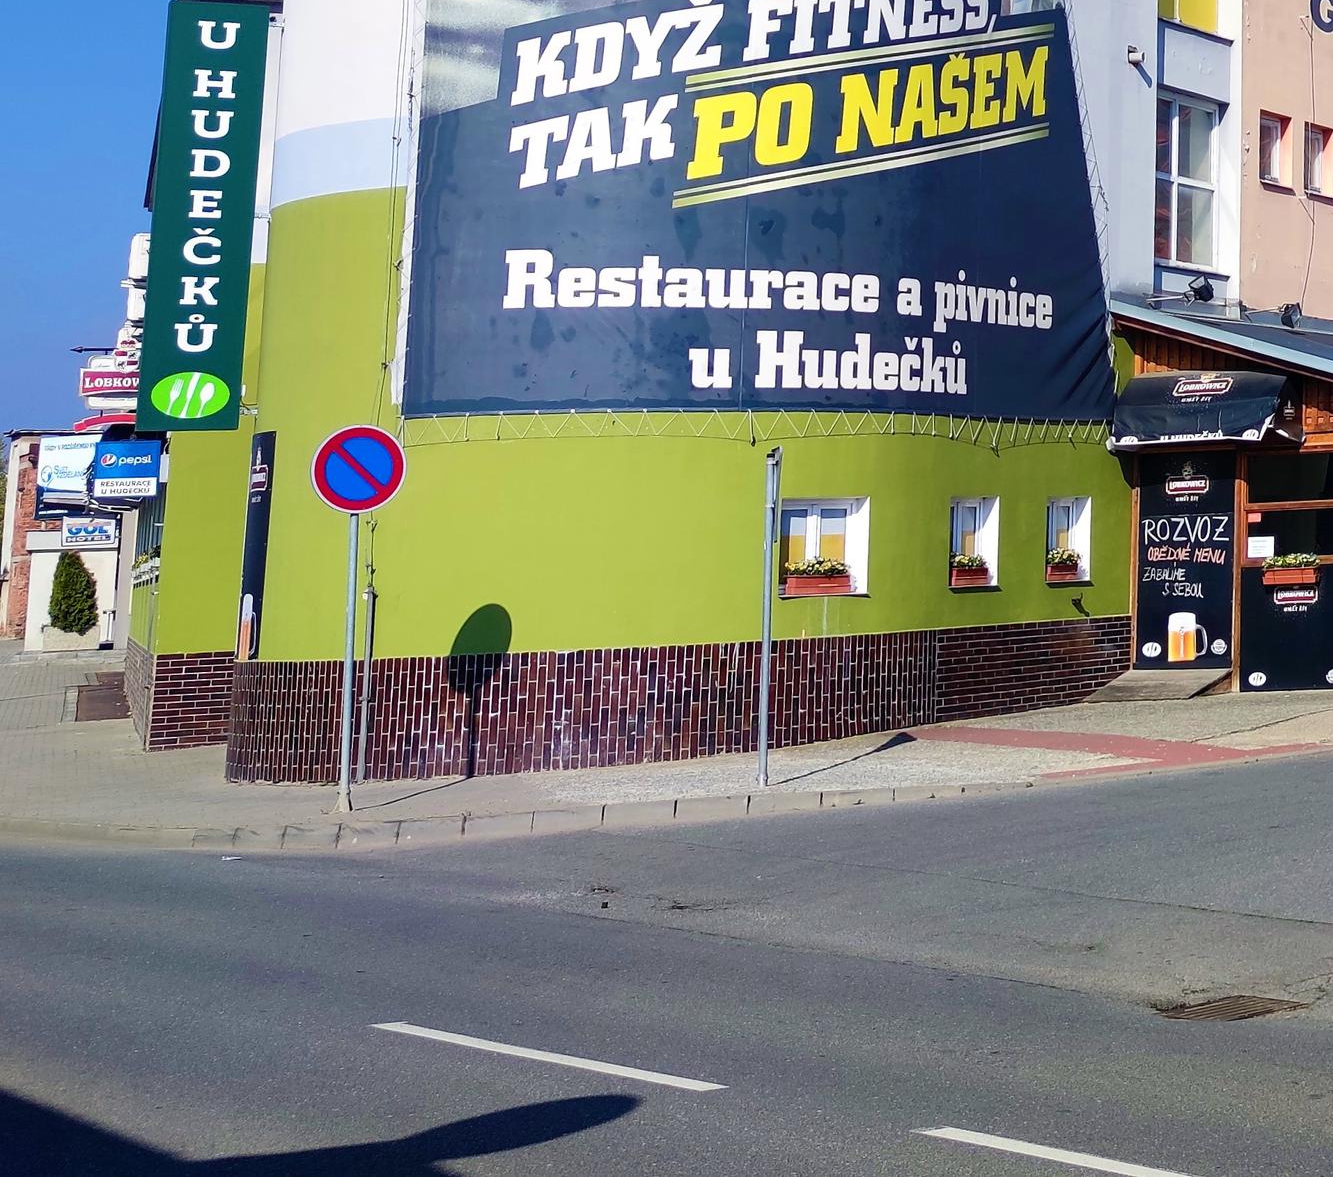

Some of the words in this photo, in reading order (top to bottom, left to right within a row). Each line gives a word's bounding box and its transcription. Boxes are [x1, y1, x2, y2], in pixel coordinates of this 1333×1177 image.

[198, 20, 241, 50] U
[508, 94, 680, 189] TAK
[687, 82, 814, 180] PO
[835, 46, 1049, 154] NAŠEM
[174, 69, 238, 353] HUDEČKŮ
[502, 248, 879, 311] Restaurace
[897, 277, 923, 316] a
[935, 269, 1053, 333] pivnice
[689, 348, 732, 389] u
[755, 330, 967, 394] Hudečků
[1178, 382, 1227, 392] LOBKOWICZ
[118, 454, 152, 466] pepsi
[1141, 516, 1229, 545] ROZVOZ
[1148, 543, 1191, 561] OBĚDOVÉ
[1193, 547, 1226, 565] MENU
[1172, 582, 1204, 598] SEBOU
